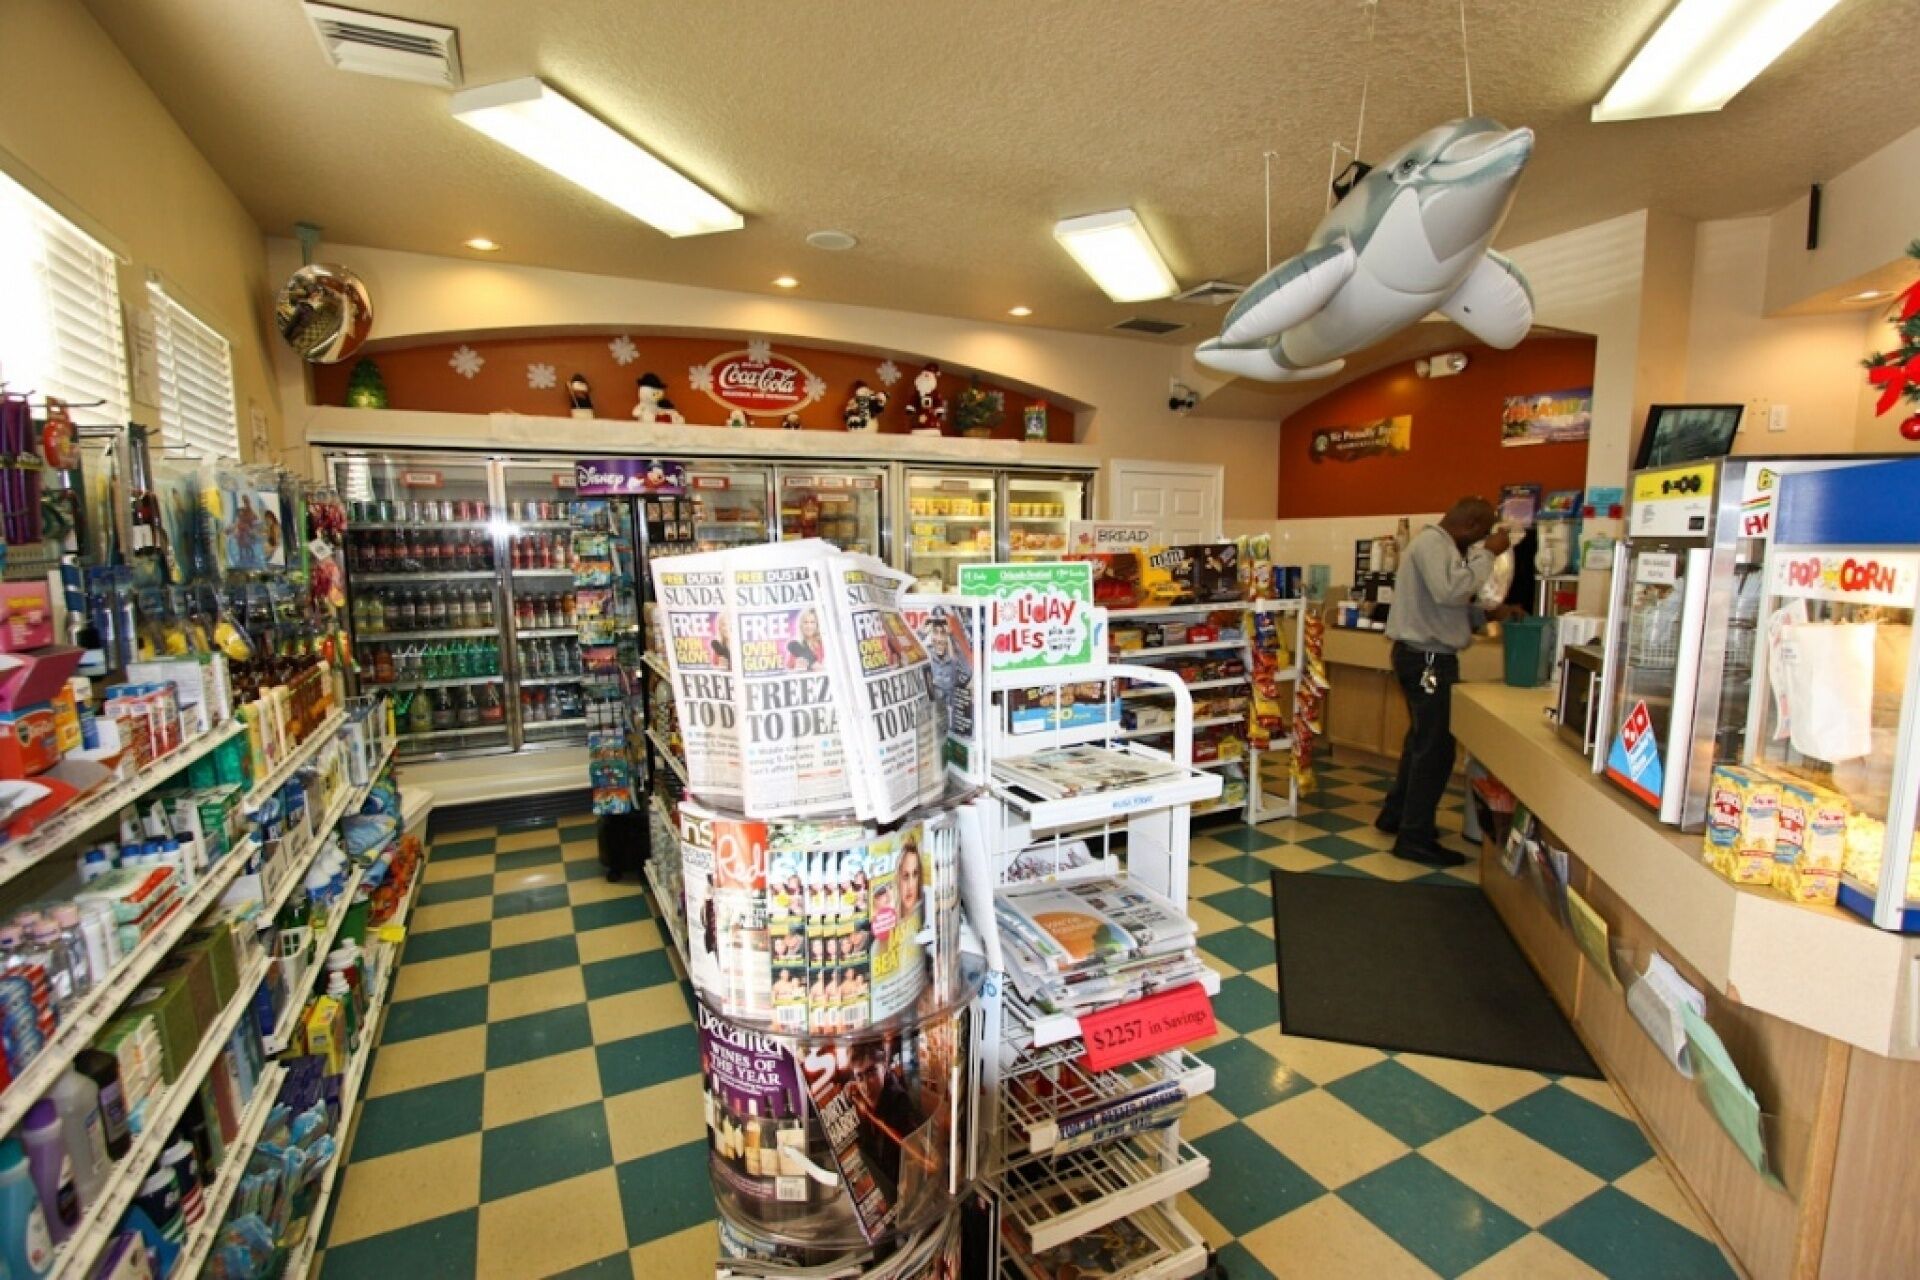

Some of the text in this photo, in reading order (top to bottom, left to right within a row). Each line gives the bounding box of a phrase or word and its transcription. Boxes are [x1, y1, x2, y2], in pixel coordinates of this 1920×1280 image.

[576, 464, 625, 489] Disney
[1097, 529, 1149, 543] BREAD
[1744, 512, 1770, 536] HO
[1787, 558, 1896, 593] POP CORN
[664, 586, 725, 605] SUNDA
[671, 612, 713, 638] FREE
[740, 613, 790, 642] FREE
[680, 673, 736, 701] FREE
[744, 674, 834, 713] FREEZ
[684, 701, 716, 727] TO
[745, 711, 784, 742] TO
[872, 708, 898, 742] TO
[1092, 1008, 1208, 1051] $2257 in Savings
[737, 1066, 781, 1087] YEAR
[753, 1058, 778, 1073] OF
